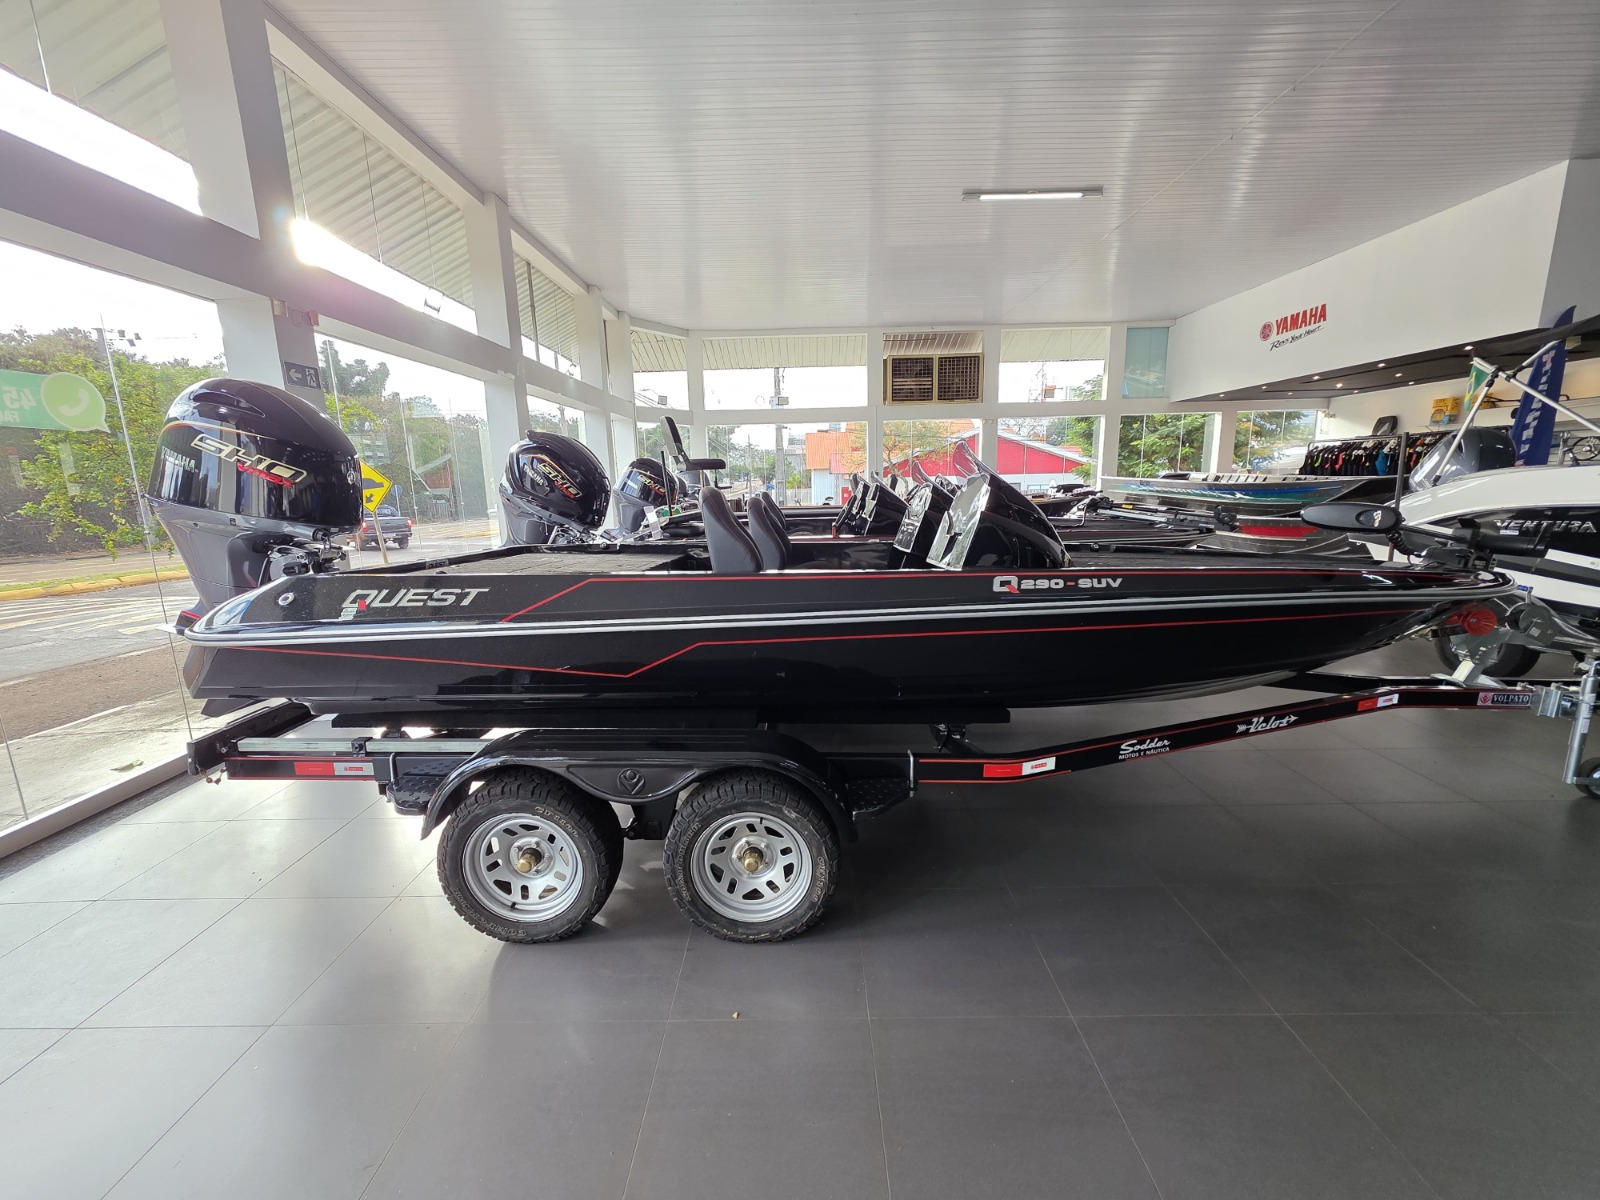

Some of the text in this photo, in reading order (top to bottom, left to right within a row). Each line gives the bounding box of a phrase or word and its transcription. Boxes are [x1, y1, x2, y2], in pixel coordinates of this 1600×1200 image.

[1275, 303, 1327, 336] YAMAHA
[161, 445, 196, 473] YAMAHA
[1493, 519, 1597, 533] VENTURA
[341, 588, 490, 610] QUEST
[1493, 694, 1529, 703] VOLPATO
[1119, 737, 1171, 754] Sodder
[1118, 752, 1139, 760] MOTOS
